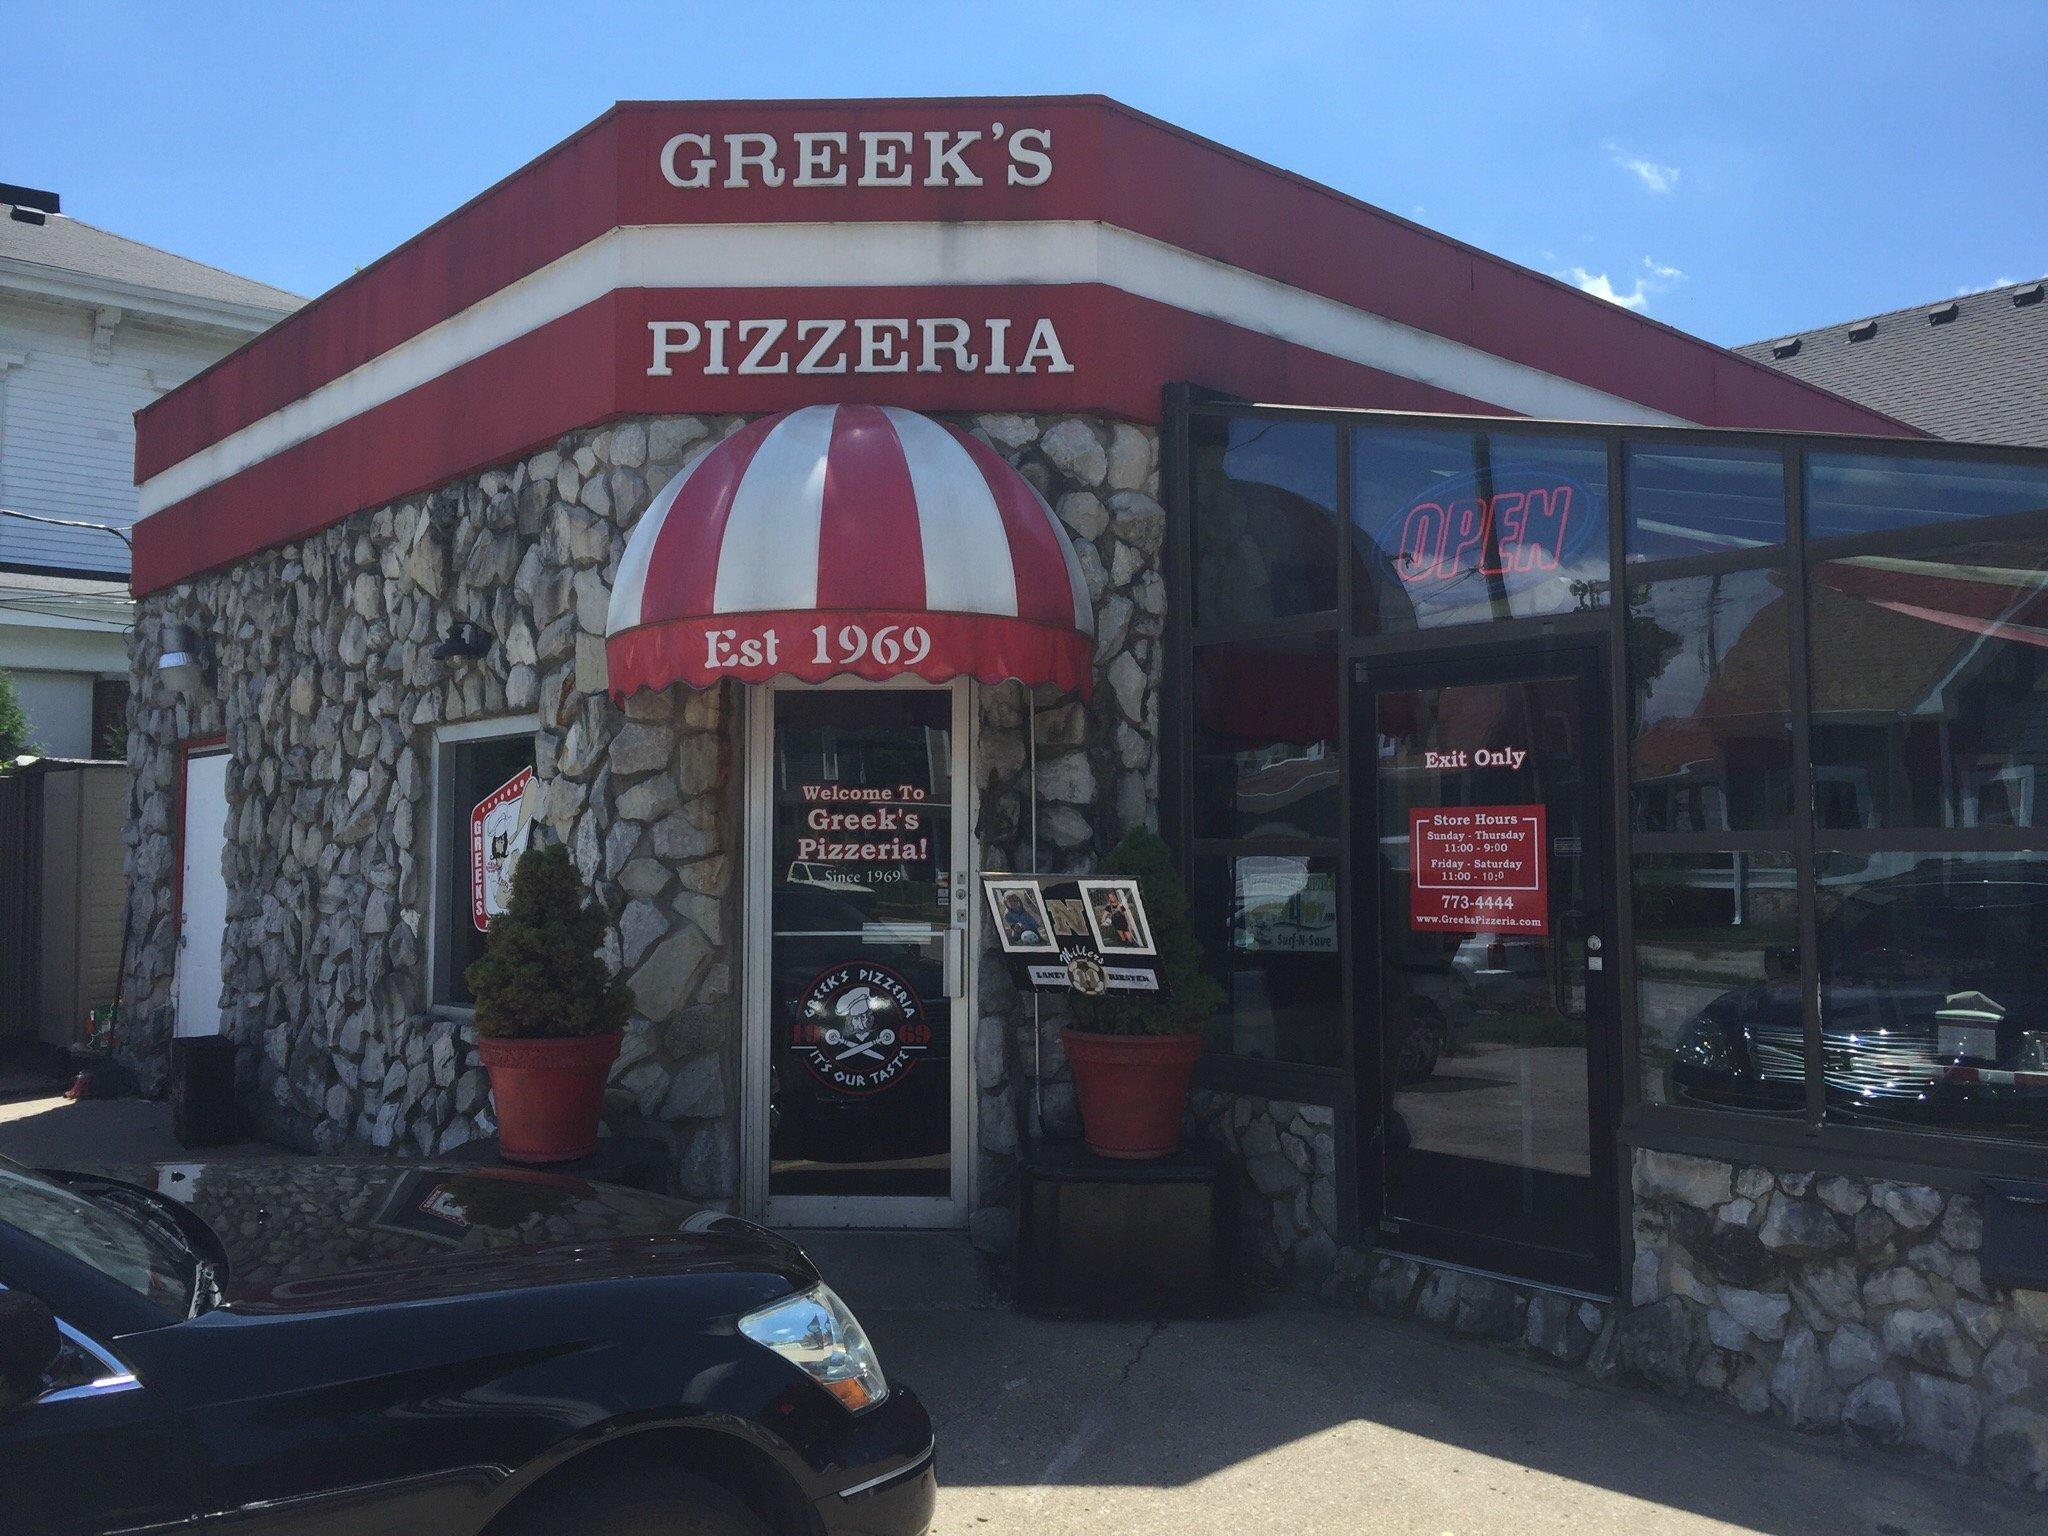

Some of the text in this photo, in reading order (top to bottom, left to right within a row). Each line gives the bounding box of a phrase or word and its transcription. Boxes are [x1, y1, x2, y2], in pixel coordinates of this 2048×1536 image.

[660, 122, 1053, 188] GREEK'S
[646, 318, 1074, 376] PIZZERIA
[1397, 486, 1573, 582] OPEN
[704, 625, 931, 668] Est 1969
[1424, 747, 1526, 769] Exit Only
[802, 785, 925, 800] Welcome To
[808, 808, 920, 830] Greek's
[1433, 813, 1518, 826] Store Hours
[1427, 830, 1465, 842] Sunday
[1475, 830, 1526, 842] Thursday
[798, 837, 928, 860] Pizzeria!
[1444, 843, 1474, 853] 11:00
[1483, 843, 1508, 853] 9:00
[473, 820, 484, 916] GREEKS
[1431, 859, 1464, 870] Friday
[1474, 859, 1522, 871] Saturday
[825, 870, 901, 883] Since 1969
[1442, 871, 1471, 881] 11:00
[1441, 894, 1514, 910] 773-4444
[1416, 914, 1542, 927] www.GreeksPizzeria.com
[1059, 944, 1104, 965] Millers
[859, 968, 916, 1019] PIZZERIA
[810, 1050, 910, 1087] IT'S OUR TASTE
